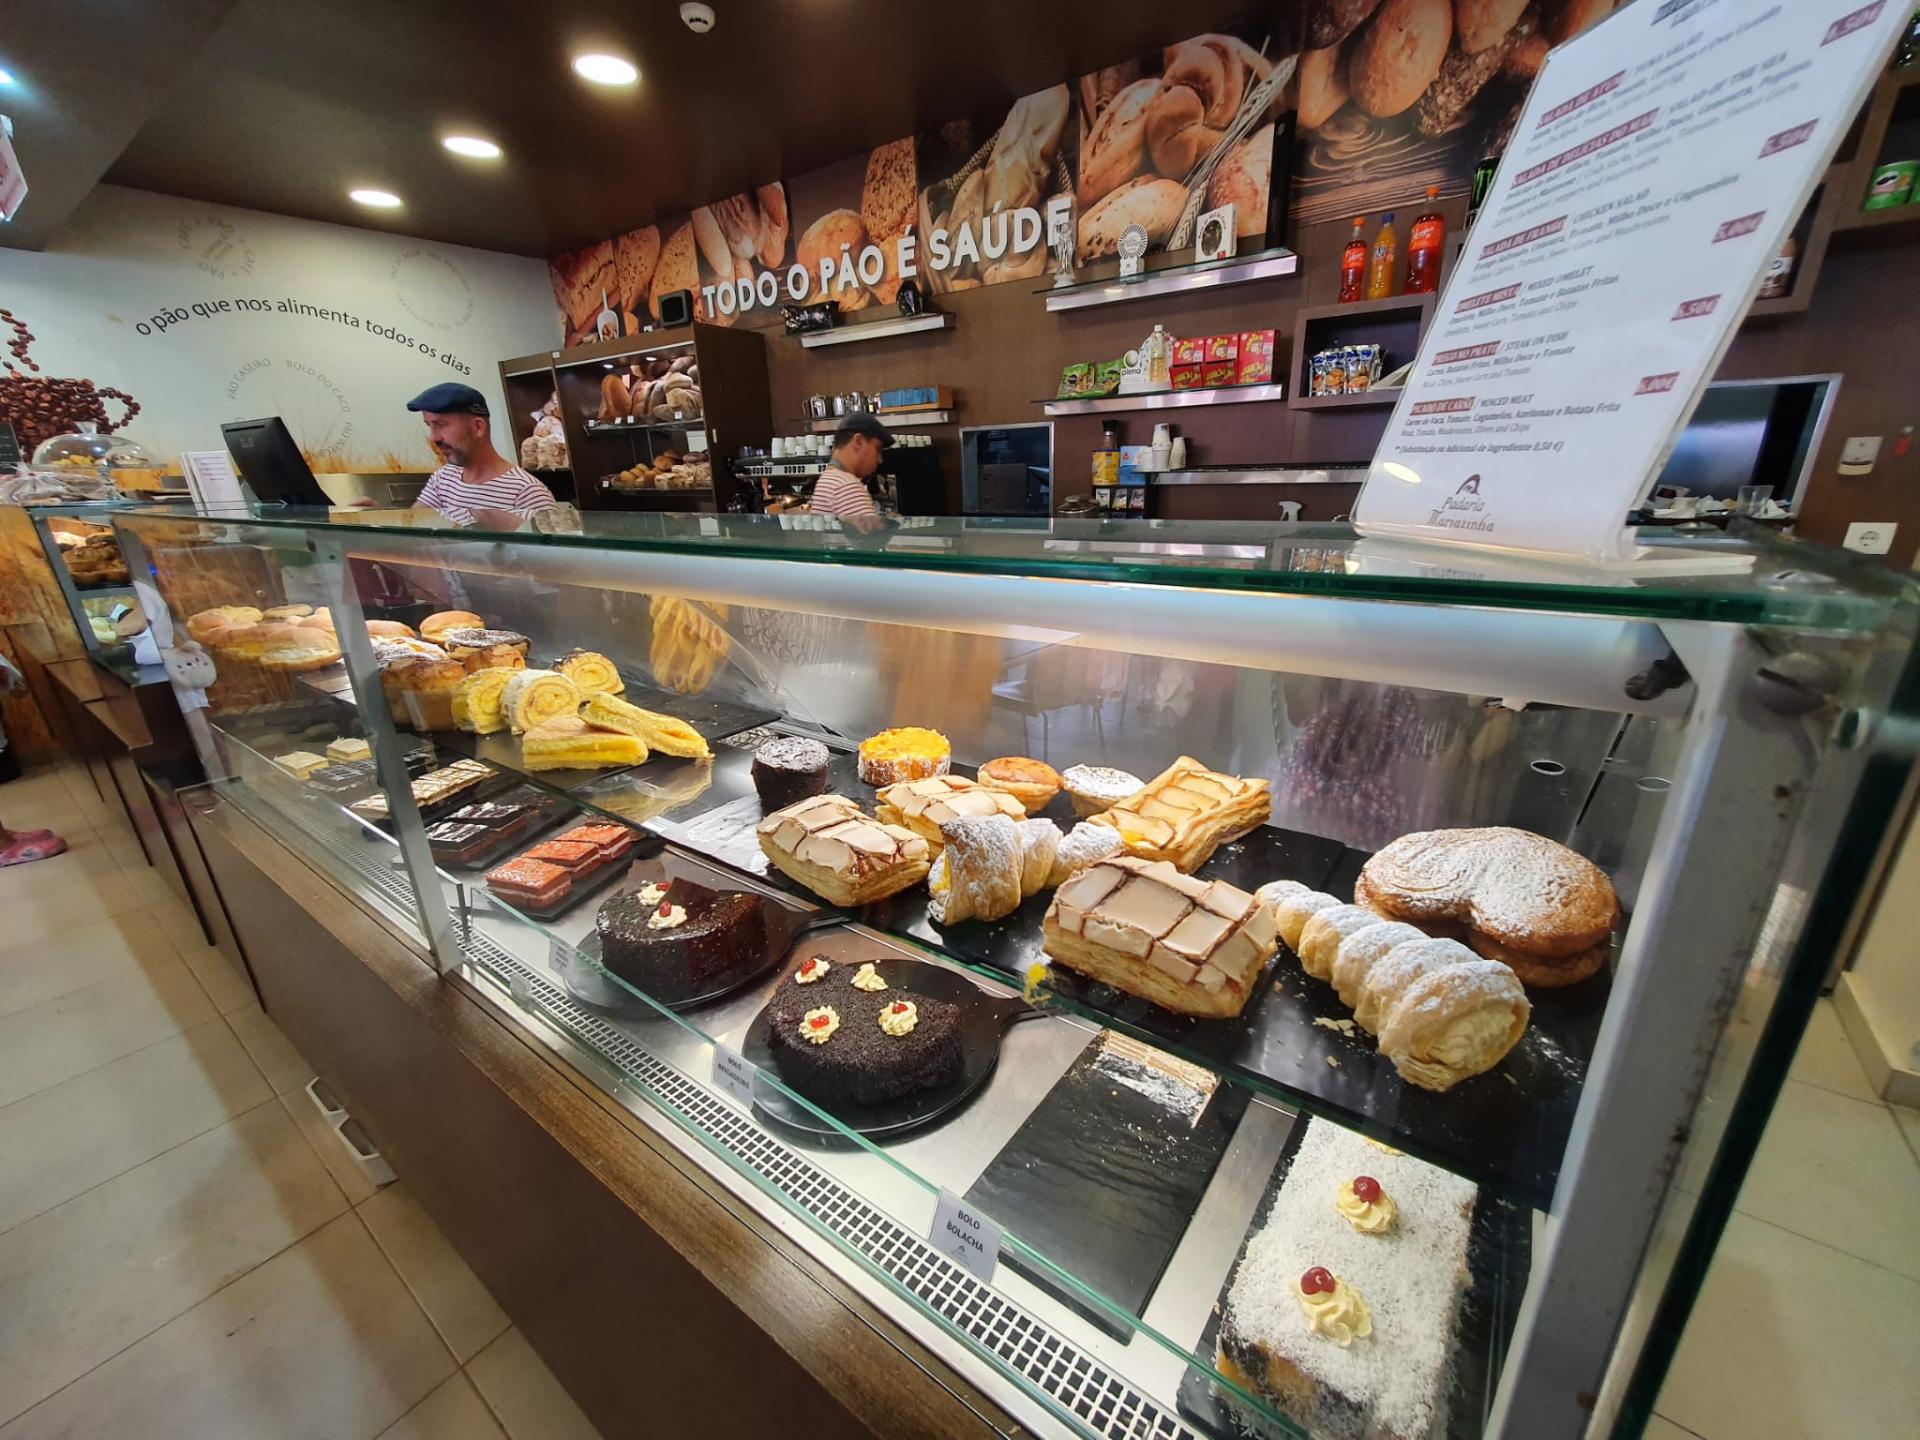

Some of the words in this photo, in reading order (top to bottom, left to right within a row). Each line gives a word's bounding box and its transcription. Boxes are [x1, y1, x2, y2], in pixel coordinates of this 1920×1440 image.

[702, 272, 778, 318] TODO
[787, 263, 809, 301] O
[820, 243, 885, 294] PÃO
[899, 225, 917, 278] É
[929, 197, 1072, 273] SAÚDE
[136, 321, 151, 336] o
[151, 307, 190, 333] pão
[193, 298, 232, 319] que
[235, 298, 272, 313] nos
[277, 297, 361, 328] alimenta
[365, 318, 415, 349] todos
[418, 341, 438, 359] os
[440, 351, 472, 376] dias
[286, 359, 315, 377] BOLO
[1442, 496, 1486, 513] Padaria
[717, 1062, 750, 1090] BRIGADEIRO
[727, 1056, 742, 1071] BOLO
[957, 1209, 981, 1232] BOLO
[946, 1220, 985, 1254] BOLACHA
